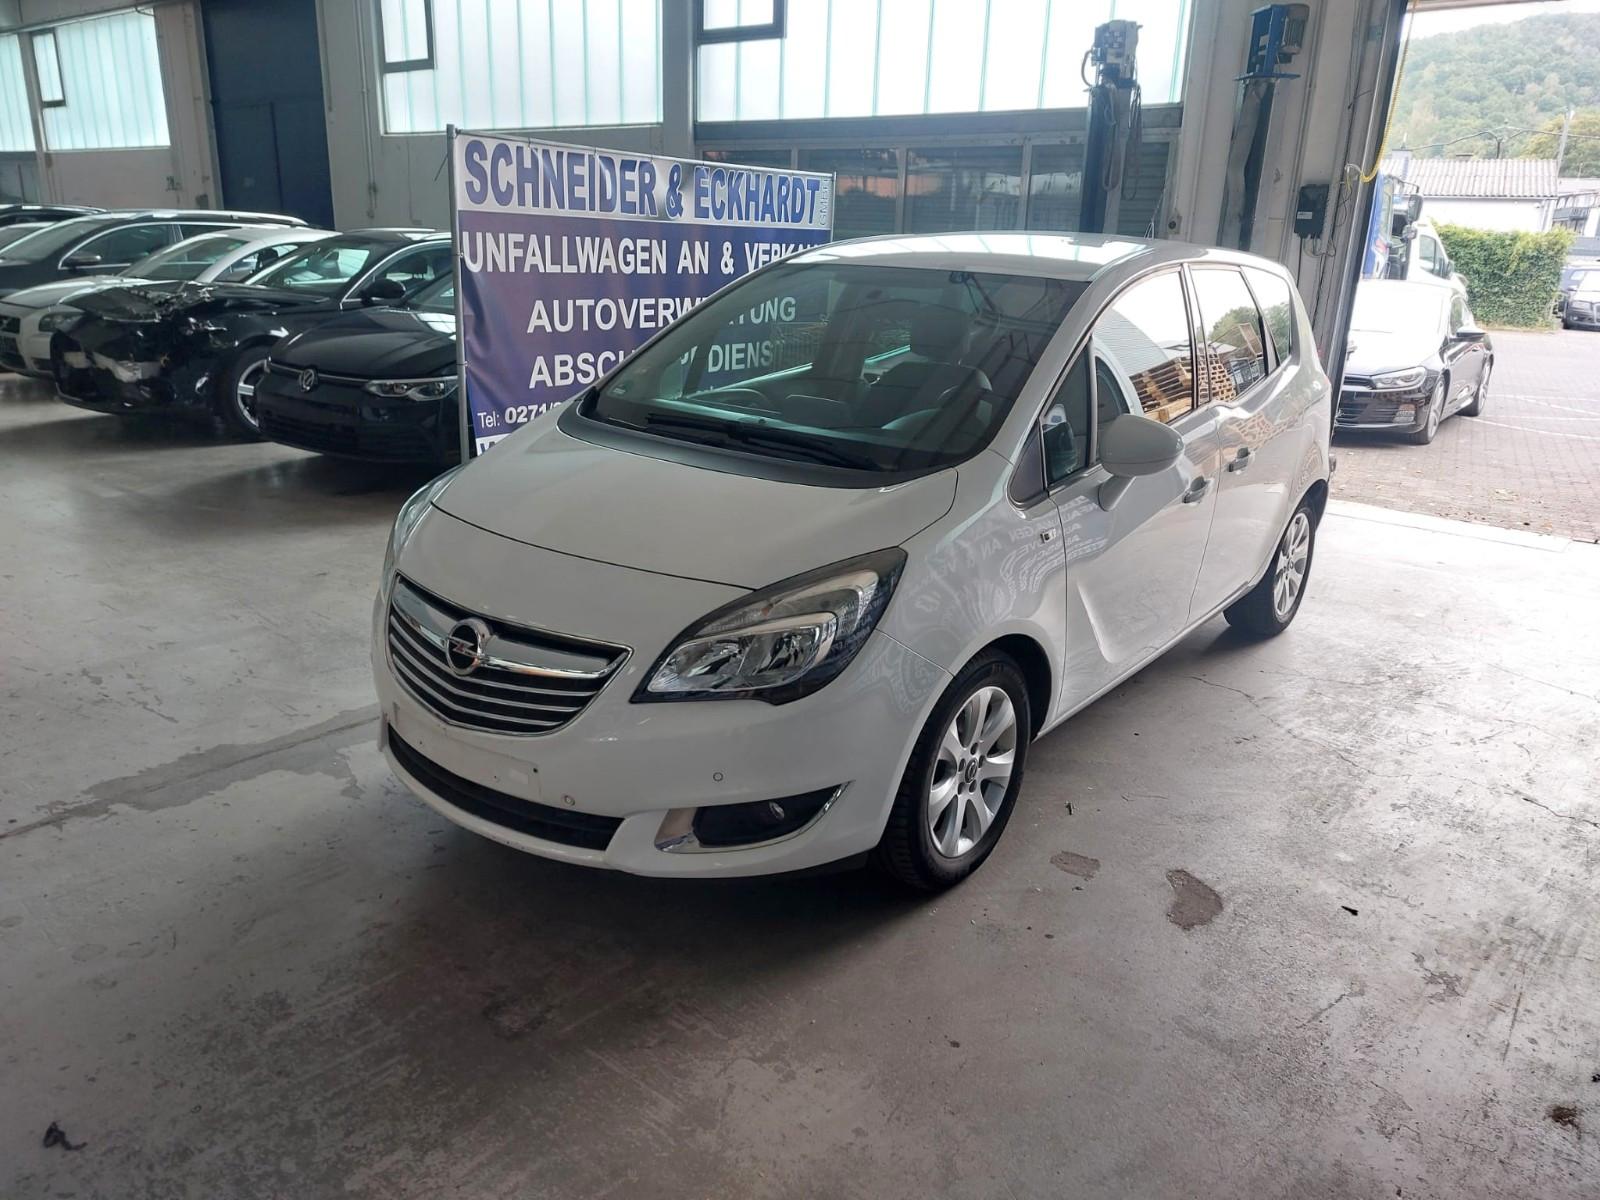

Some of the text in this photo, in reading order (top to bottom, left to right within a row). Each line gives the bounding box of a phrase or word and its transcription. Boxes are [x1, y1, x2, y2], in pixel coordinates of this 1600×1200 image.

[464, 138, 822, 225] SCHNEIDER & ECKHARDT
[462, 231, 667, 275] UNFALLWAGEN
[677, 240, 710, 275] AN
[720, 241, 735, 275] &
[477, 412, 501, 429] Tel:
